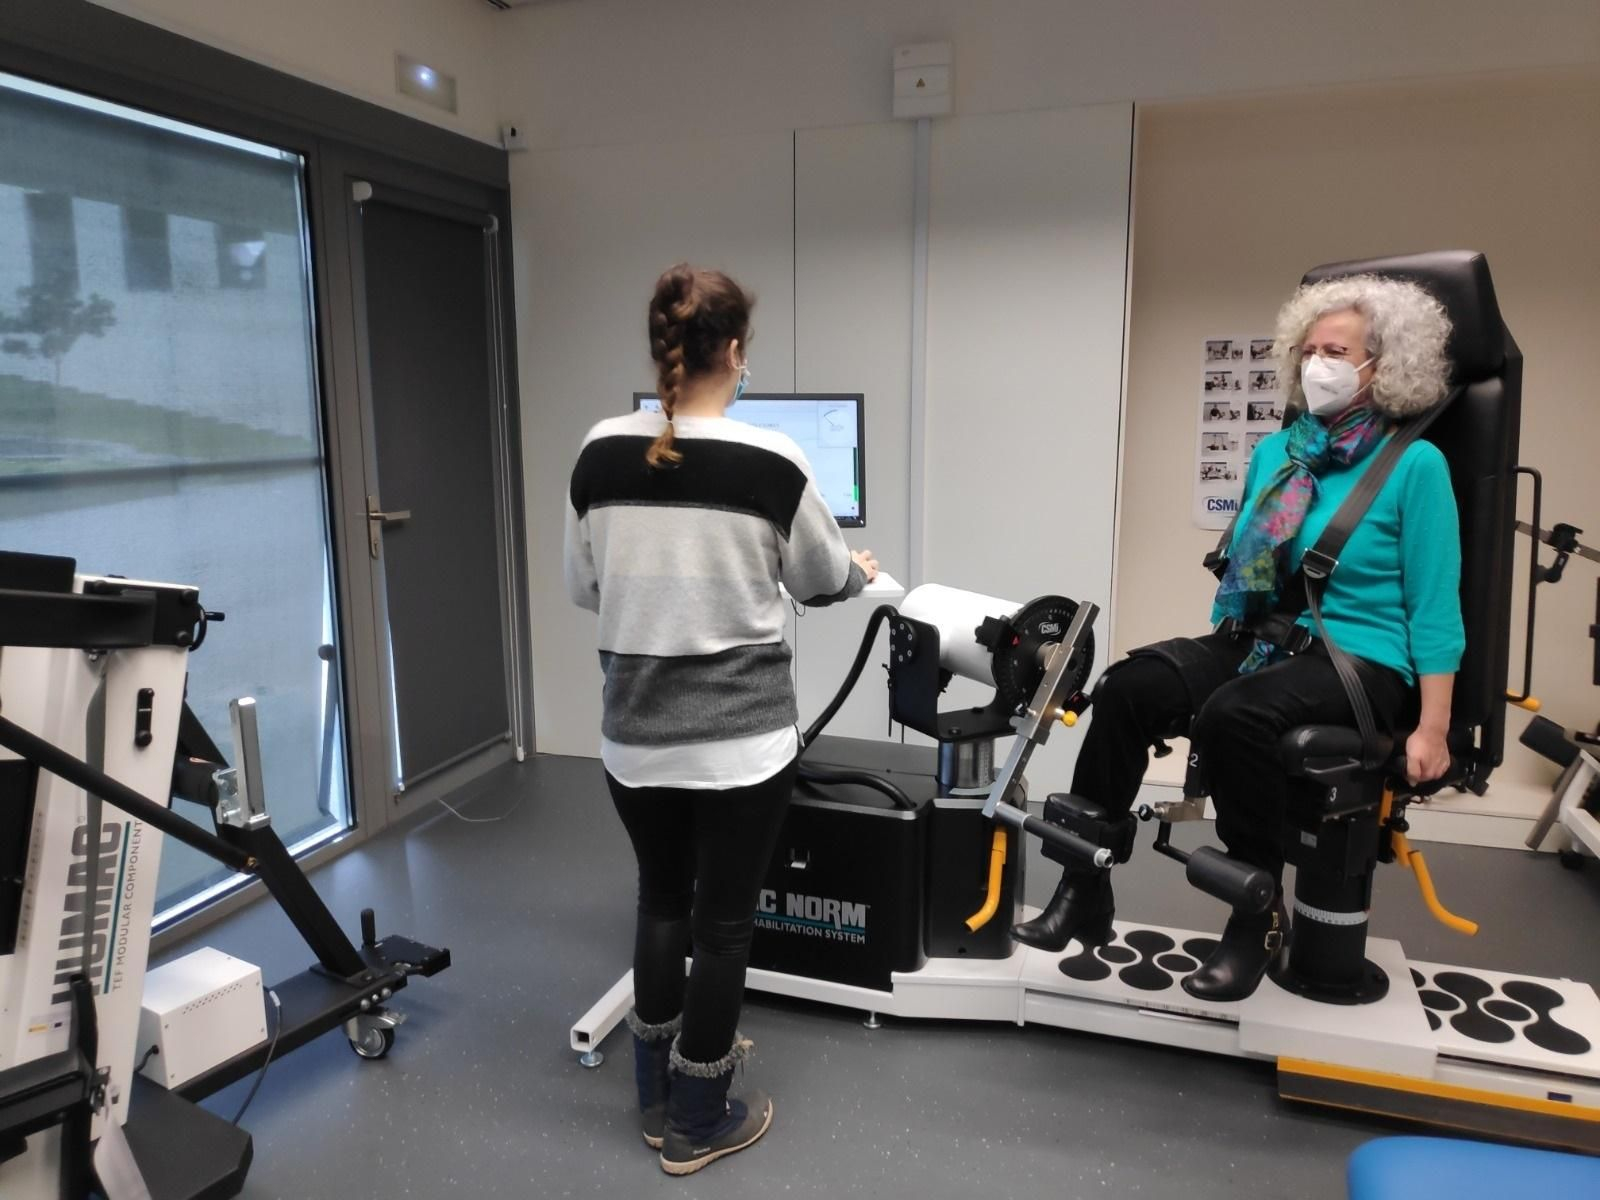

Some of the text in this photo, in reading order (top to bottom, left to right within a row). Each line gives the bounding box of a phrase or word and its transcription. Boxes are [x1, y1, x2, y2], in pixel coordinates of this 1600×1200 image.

[1189, 753, 1199, 768] 2
[1330, 787, 1337, 802] 3
[112, 820, 143, 992] TEF MODULAR COMPONENT
[786, 892, 866, 930] NORM
[824, 929, 866, 945] SYSTEM
